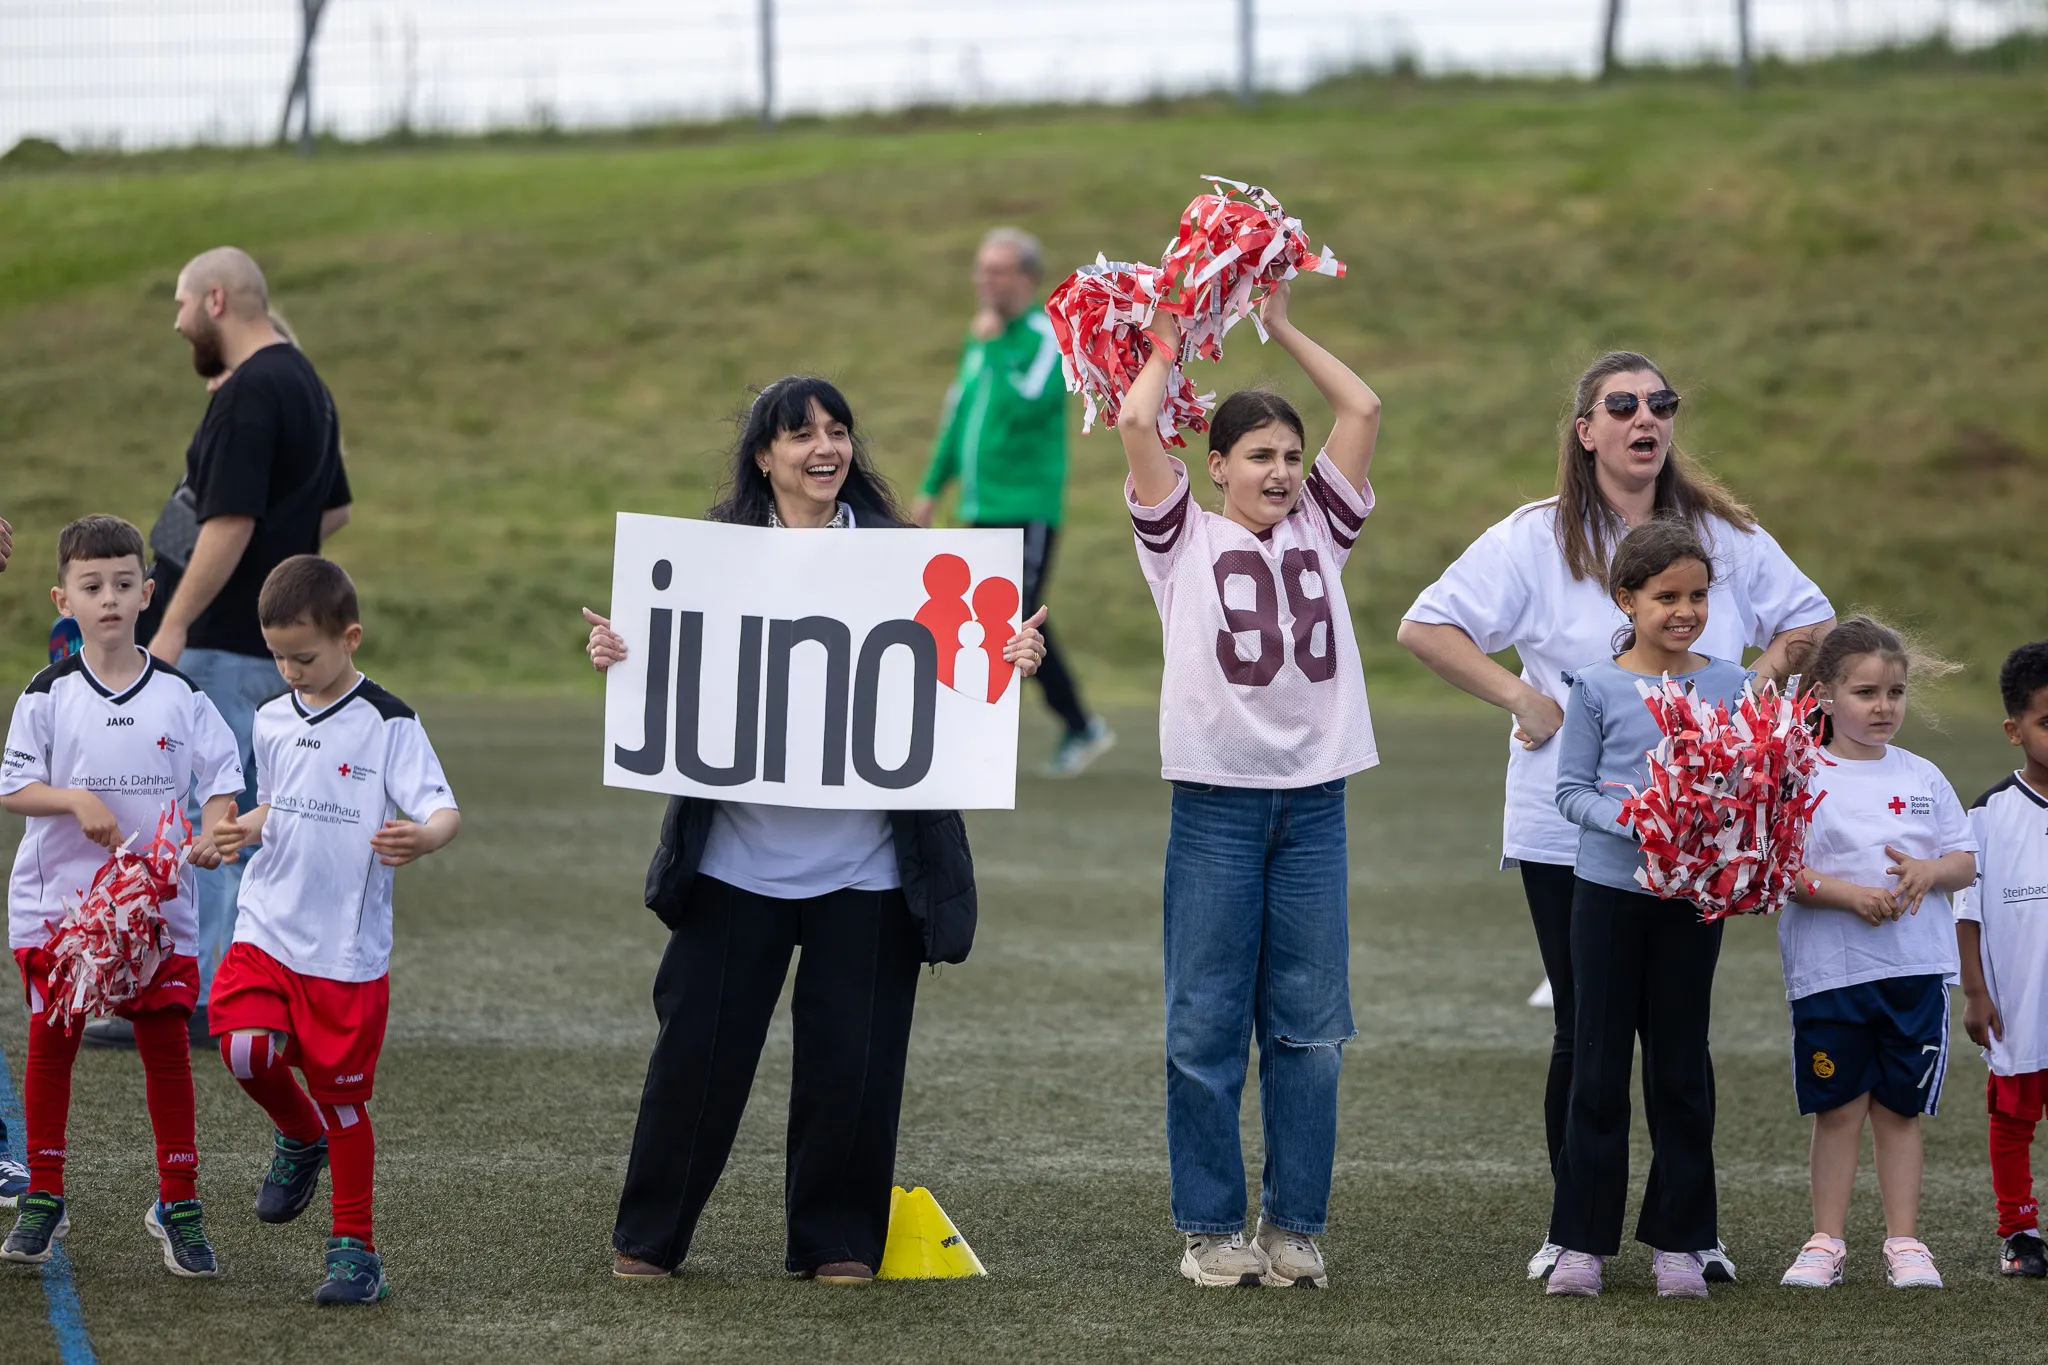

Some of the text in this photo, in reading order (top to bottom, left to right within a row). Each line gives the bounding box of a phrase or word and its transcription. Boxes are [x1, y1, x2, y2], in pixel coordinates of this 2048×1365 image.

[1212, 547, 1337, 686] 98
[613, 558, 938, 790] juno
[106, 717, 135, 727] JAKO
[295, 737, 321, 749] JAKO
[119, 775, 128, 786] &
[121, 788, 165, 796] IMMOBILIEN
[308, 798, 361, 818] Dahlhaus
[2003, 885, 2048, 899] Steinbac
[1916, 1045, 1940, 1089] 7
[346, 1072, 364, 1083] JAKO
[167, 1152, 195, 1163] JAKO
